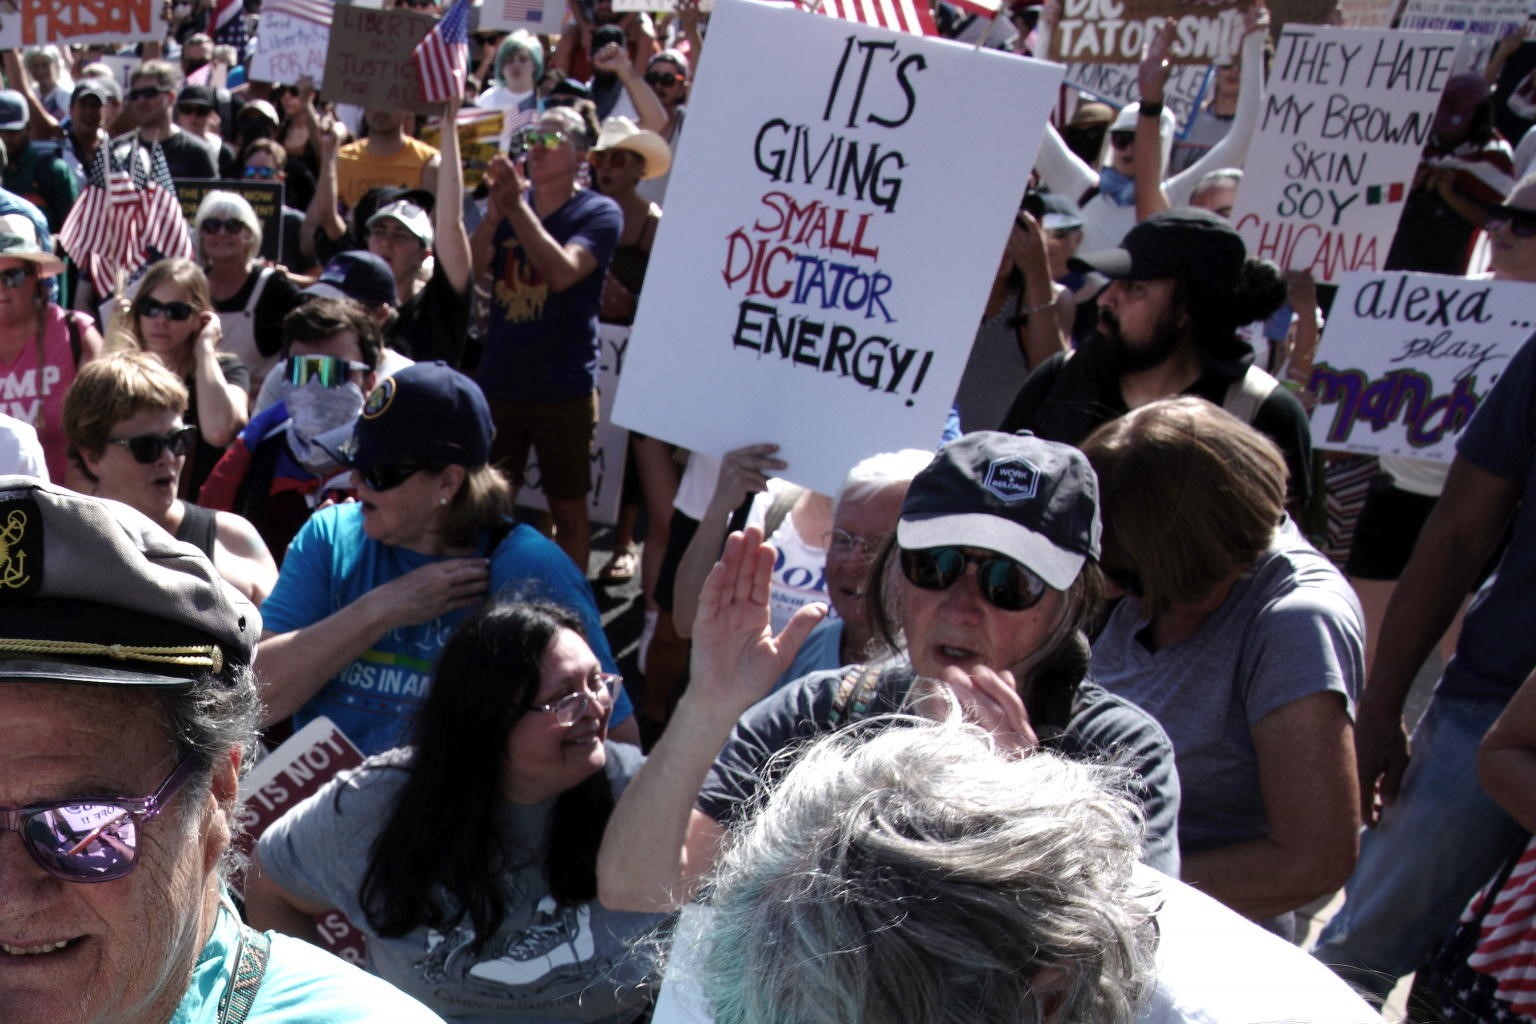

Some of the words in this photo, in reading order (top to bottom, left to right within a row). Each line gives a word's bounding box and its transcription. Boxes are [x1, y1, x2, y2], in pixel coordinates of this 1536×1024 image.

[21, 0, 151, 45] PRISON
[823, 35, 927, 129] IT'S
[1281, 32, 1362, 86] THEY
[1366, 38, 1455, 92] HATE
[1261, 94, 1314, 135] MY
[1321, 94, 1434, 146] BROWN
[754, 118, 910, 213] GIVING
[1285, 141, 1366, 186] SKIN
[753, 191, 879, 263] SMALL
[1277, 183, 1360, 226] SOY
[722, 225, 897, 323] DICTATOR
[1354, 275, 1493, 327] alexa
[732, 300, 934, 408] ENERGY!
[1390, 330, 1510, 386] play
[991, 480, 1029, 492] BELONG
[999, 468, 1028, 480] WORK
[378, 669, 402, 694] IN
[254, 780, 289, 812] IS
[282, 728, 345, 788] NOT
[316, 913, 349, 945] IS
